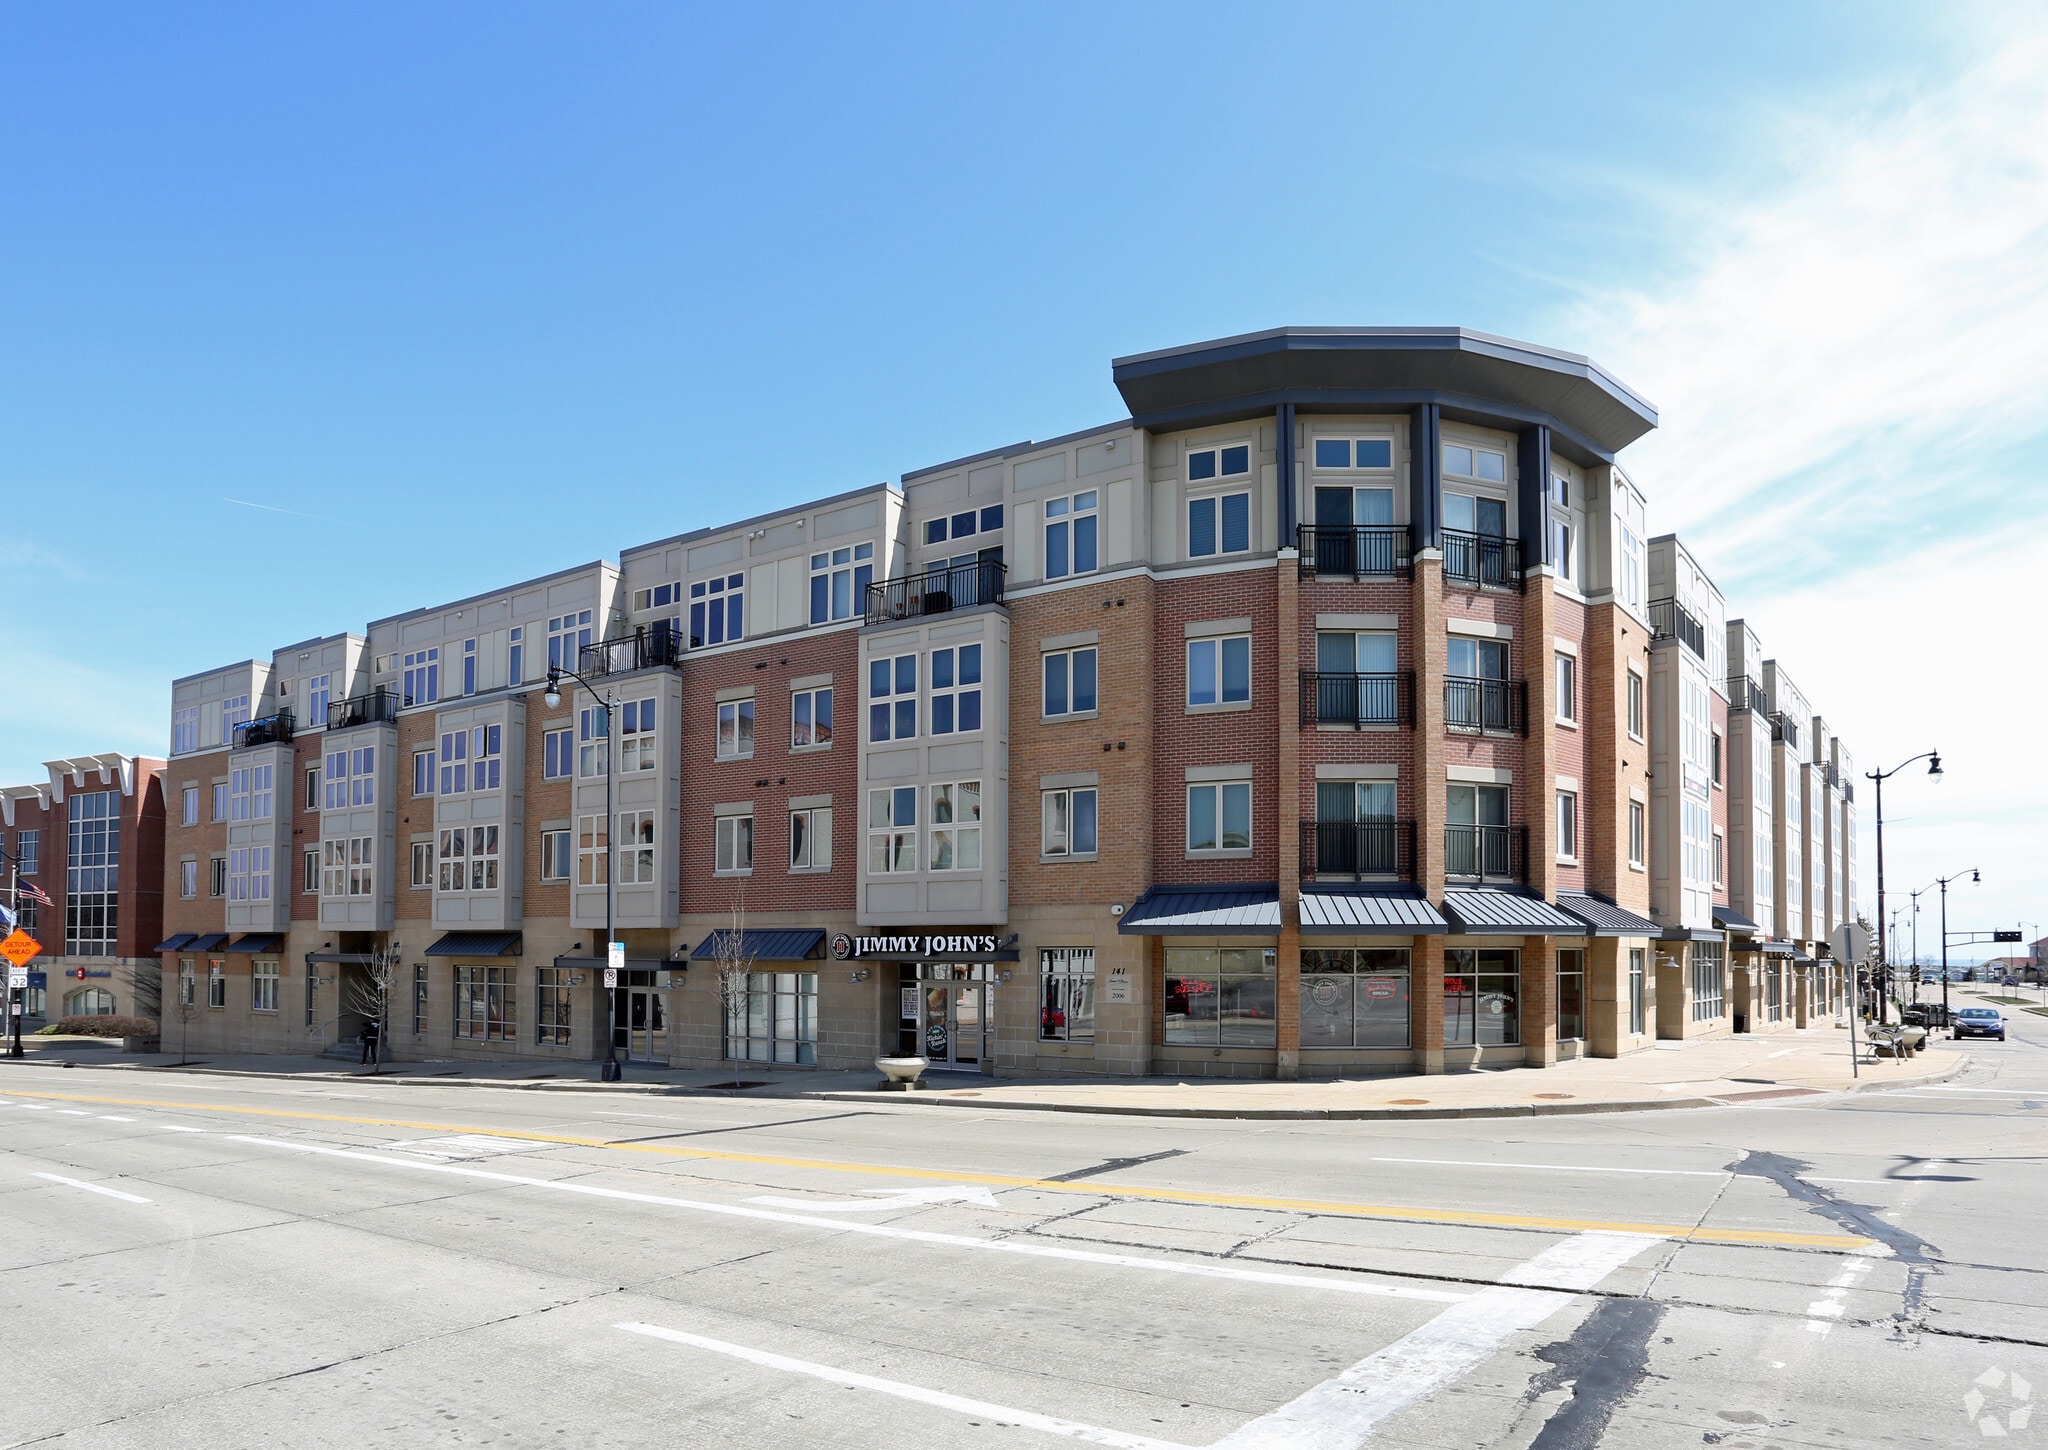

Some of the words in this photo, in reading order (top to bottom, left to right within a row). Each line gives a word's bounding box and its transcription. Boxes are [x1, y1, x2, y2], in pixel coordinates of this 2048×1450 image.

[854, 936, 919, 957] JIMMY
[924, 935, 996, 957] JOHN'S
[1111, 967, 1126, 975] 141
[12, 978, 26, 986] 32
